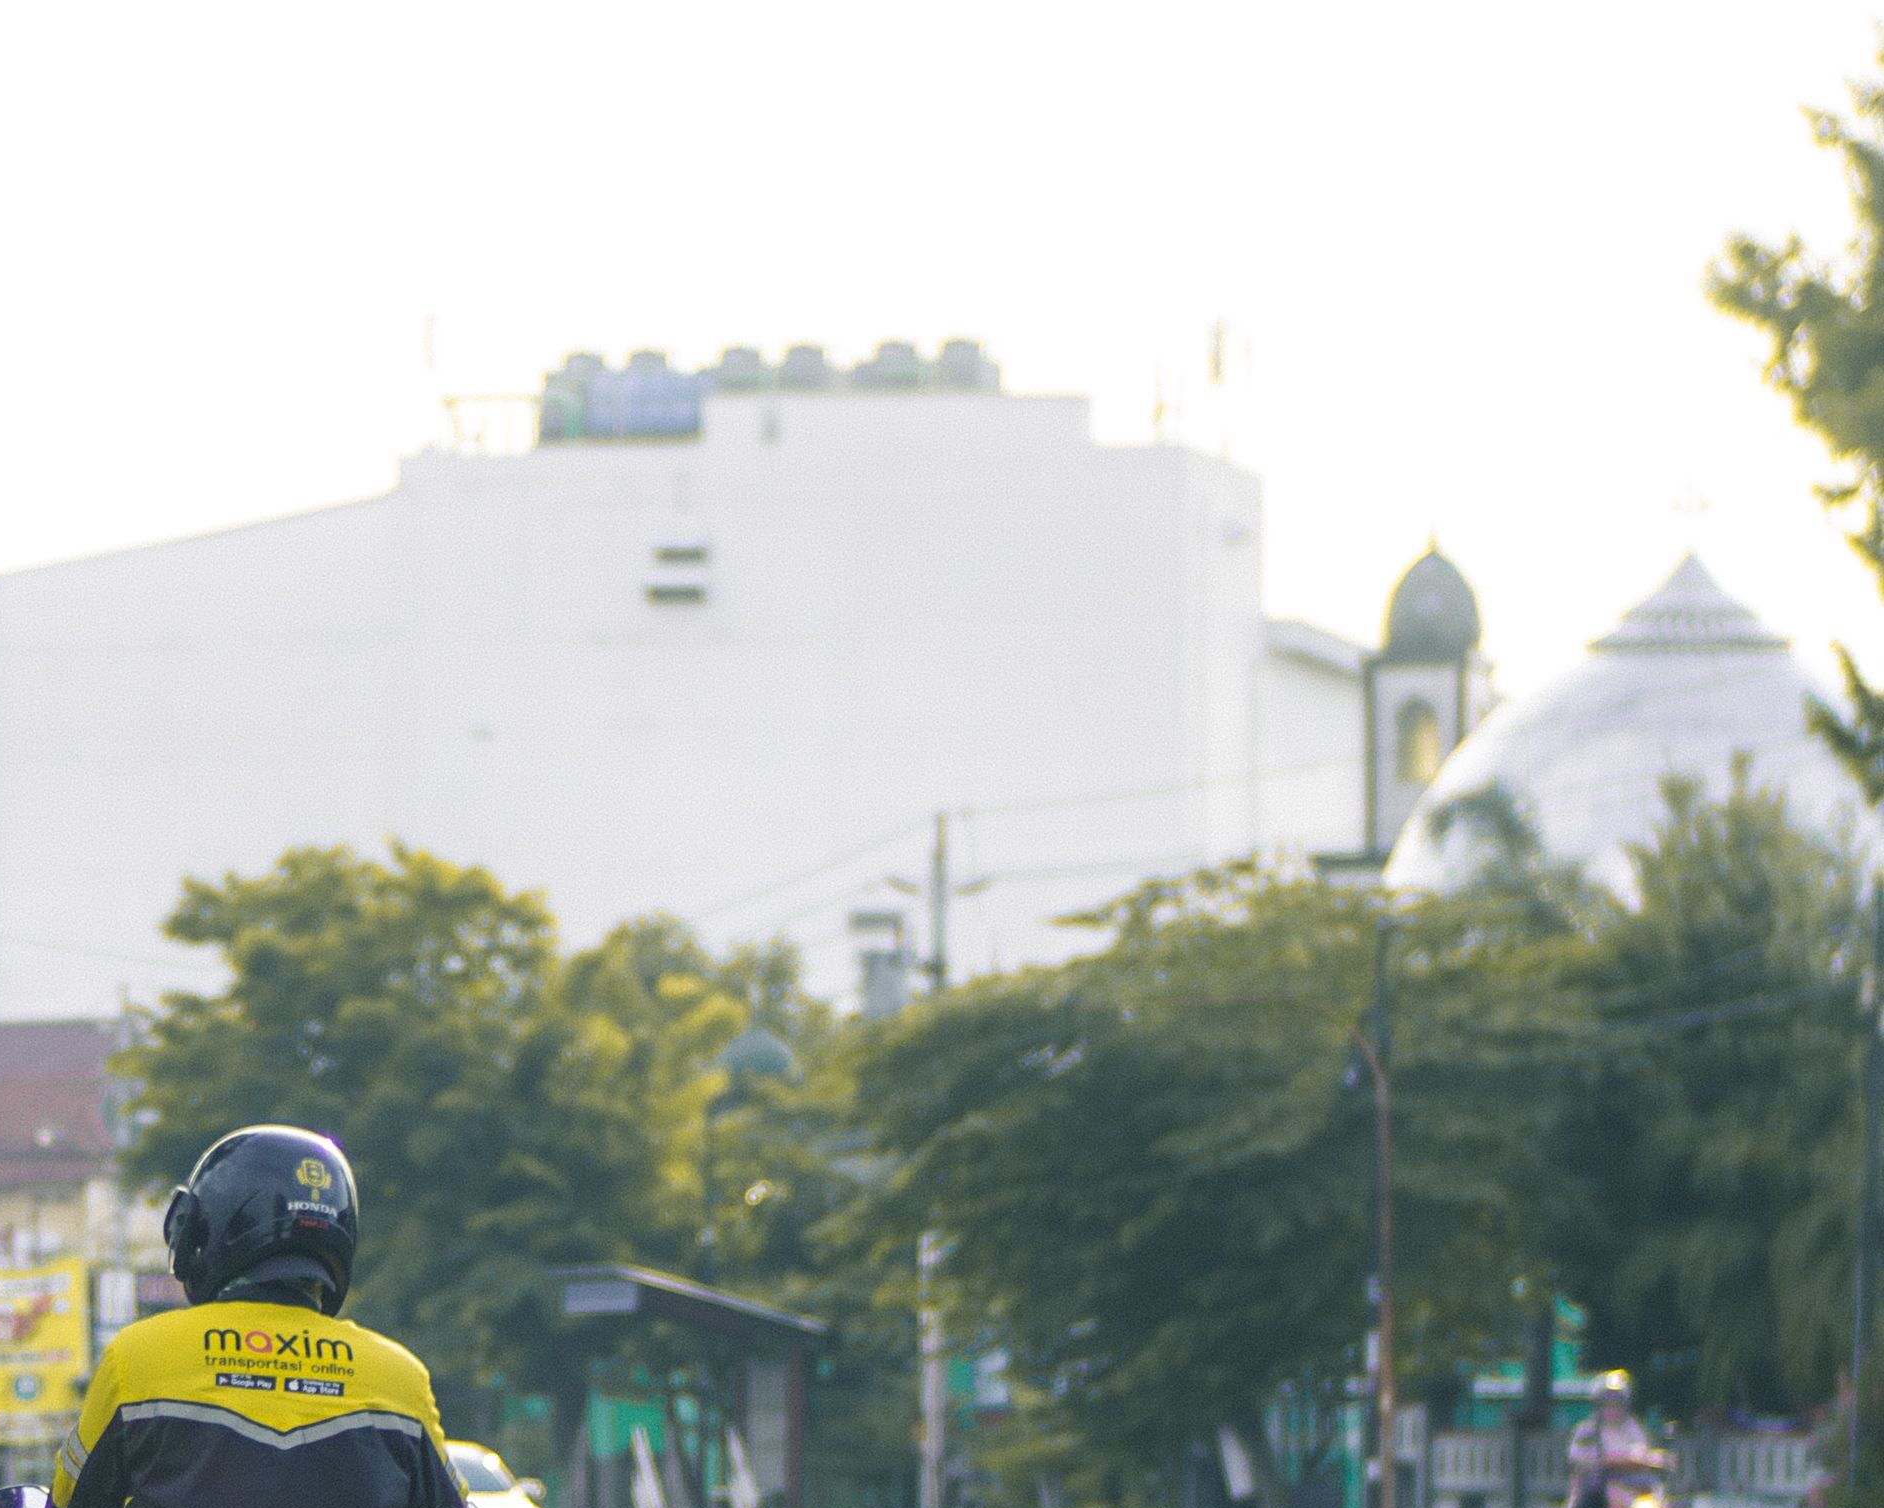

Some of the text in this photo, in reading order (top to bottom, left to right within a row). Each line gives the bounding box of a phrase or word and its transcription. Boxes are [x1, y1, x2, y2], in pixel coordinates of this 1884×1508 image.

[287, 1201, 338, 1218] HONDA
[204, 1328, 354, 1361] maxim
[205, 1355, 355, 1377] transportasi online
[230, 1377, 273, 1390] Google Play
[302, 1384, 340, 1395] App Store
